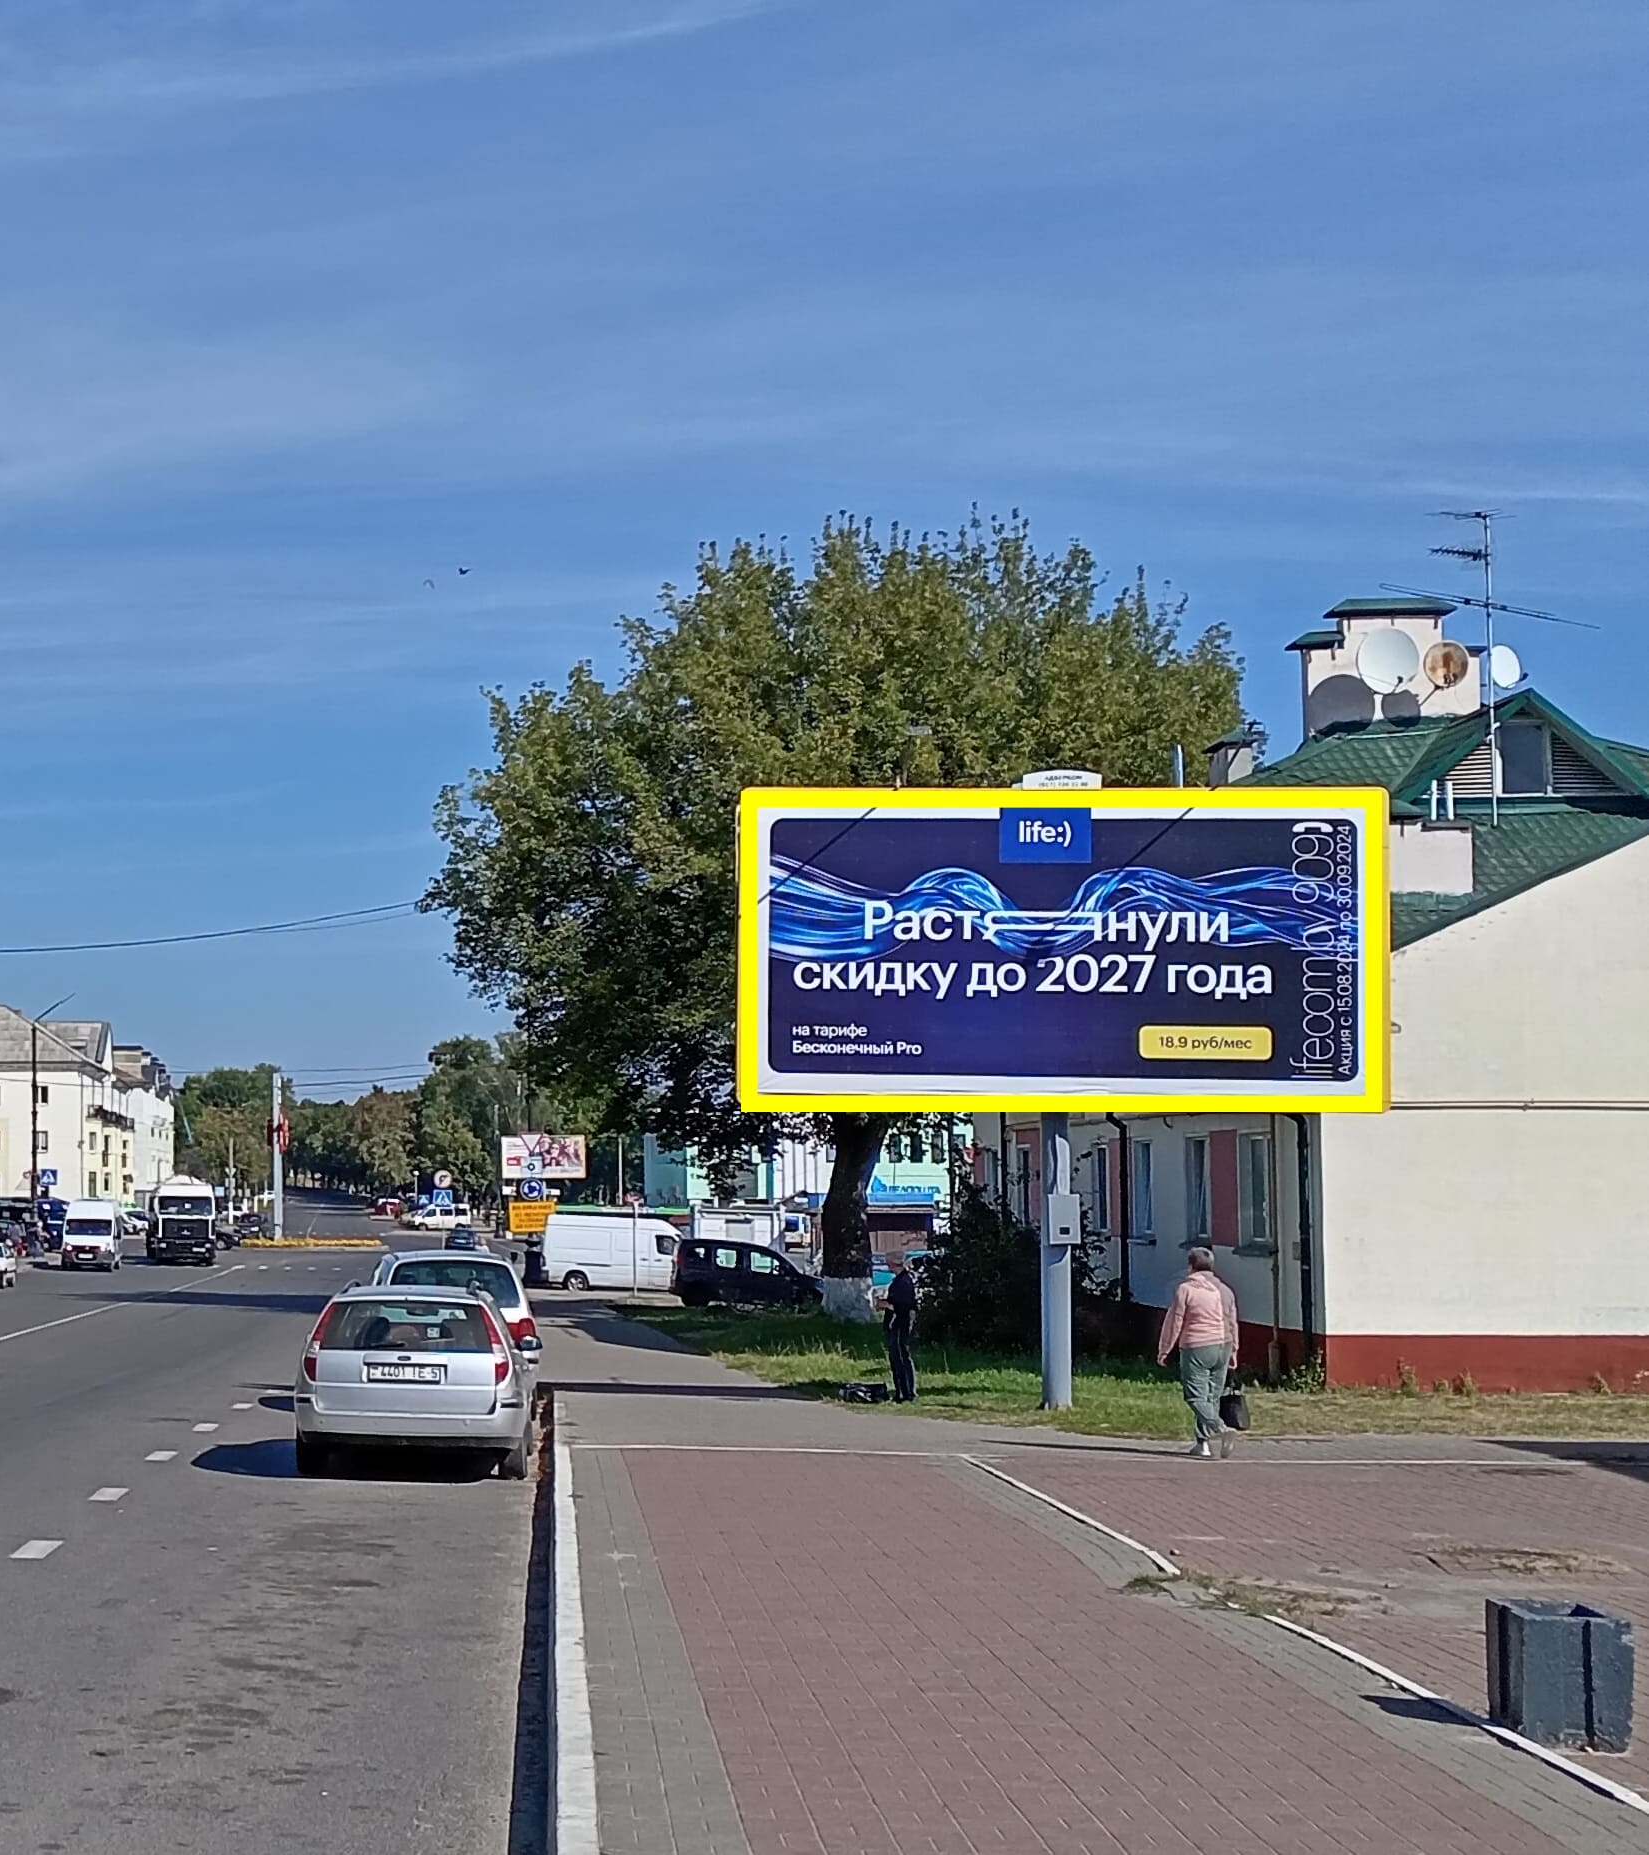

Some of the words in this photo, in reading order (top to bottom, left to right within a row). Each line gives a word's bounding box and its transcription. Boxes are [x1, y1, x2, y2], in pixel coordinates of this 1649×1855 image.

[1018, 820, 1072, 847] life:)
[1292, 834, 1335, 904] 909
[1337, 826, 1352, 908] 30.09.2024
[1340, 911, 1352, 930] по
[793, 961, 958, 1000] скидку
[966, 962, 1027, 998] до
[1035, 954, 1156, 993] 2027
[1167, 964, 1272, 1000] года
[1337, 935, 1353, 1013] 15.08.2024
[792, 1025, 810, 1036] на
[813, 1023, 868, 1039] тарифе
[792, 1040, 894, 1055] Бесконечный
[896, 1041, 922, 1055] Pro
[1191, 1036, 1253, 1050] руб/мес
[1338, 1028, 1353, 1075] Акция
